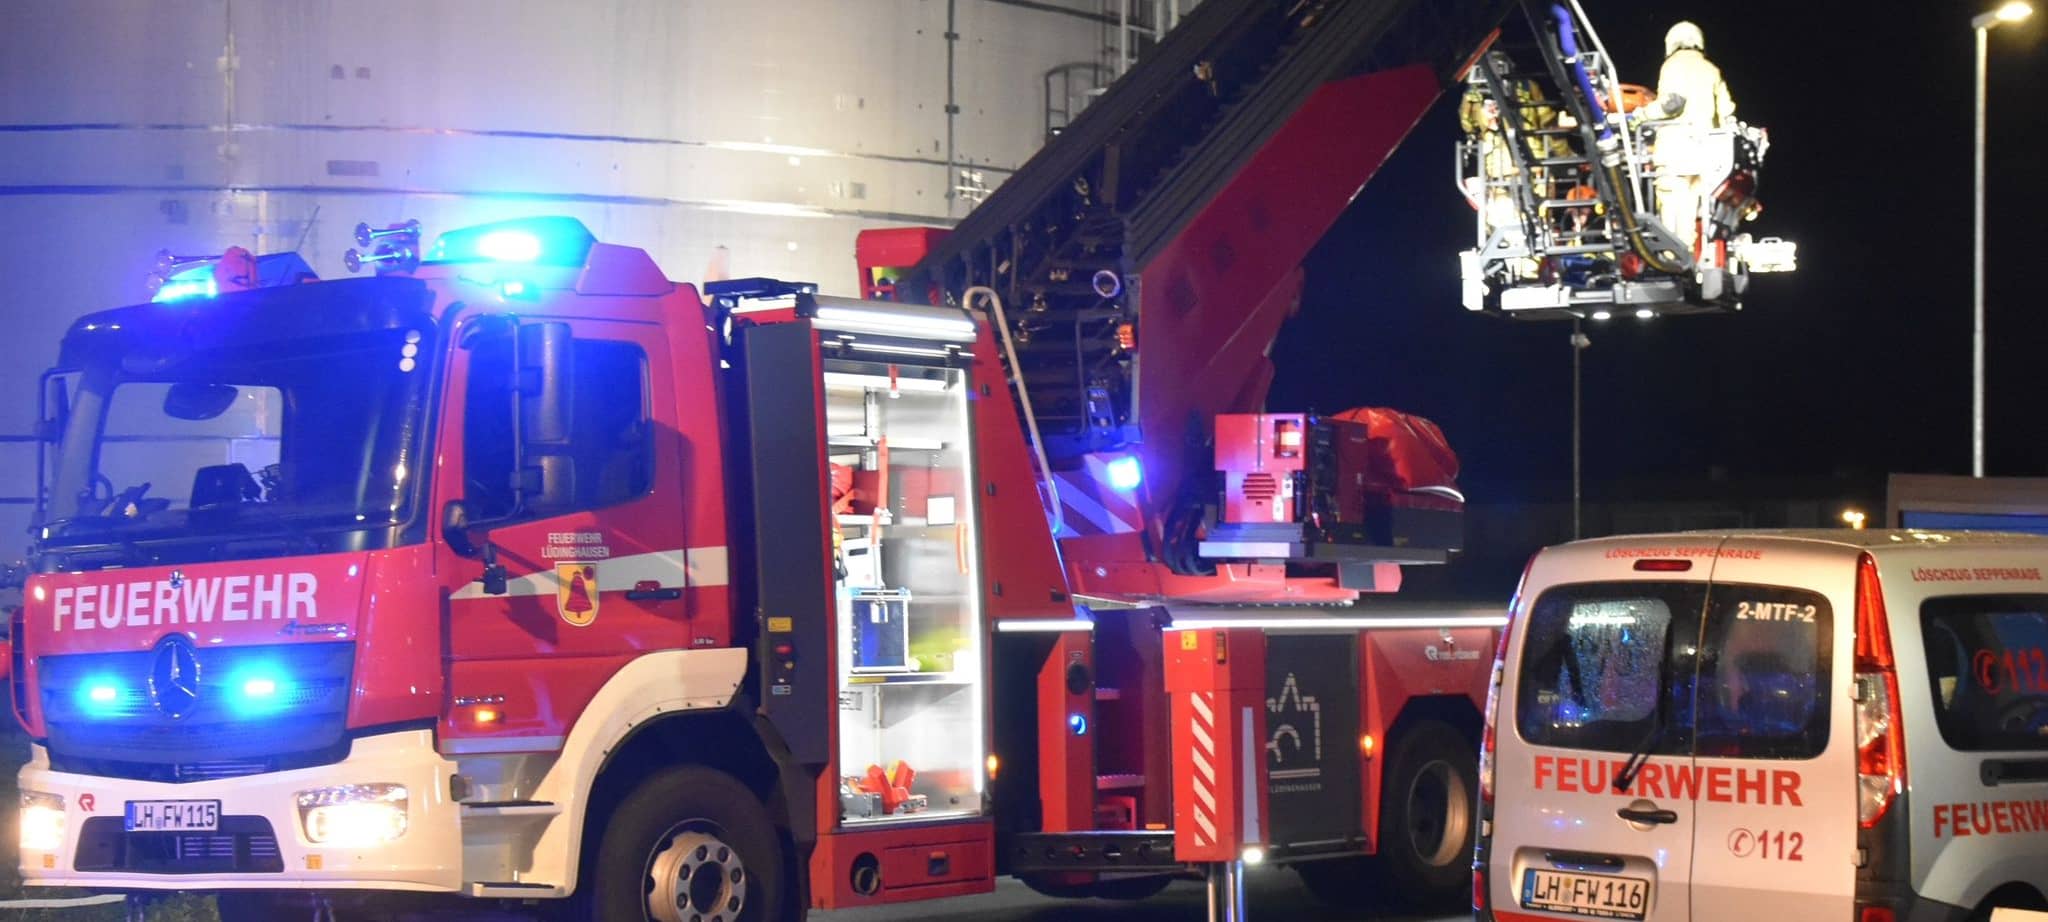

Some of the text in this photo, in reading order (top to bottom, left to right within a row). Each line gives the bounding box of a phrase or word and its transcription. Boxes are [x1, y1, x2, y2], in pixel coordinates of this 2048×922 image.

[548, 532, 602, 544] FEUERWEHR
[1605, 546, 1762, 560] LÖSCHZUG SEPPENRADE
[1911, 566, 2042, 582] LÖSCHZUG SEPPENRADE
[53, 572, 318, 632] FEUERWEHR
[1737, 602, 1816, 623] 2-MTF-2
[2002, 649, 2048, 693] 112
[134, 805, 216, 827] LH FW 115
[1757, 831, 1804, 861] 112
[1535, 875, 1641, 908] LH FW 116
